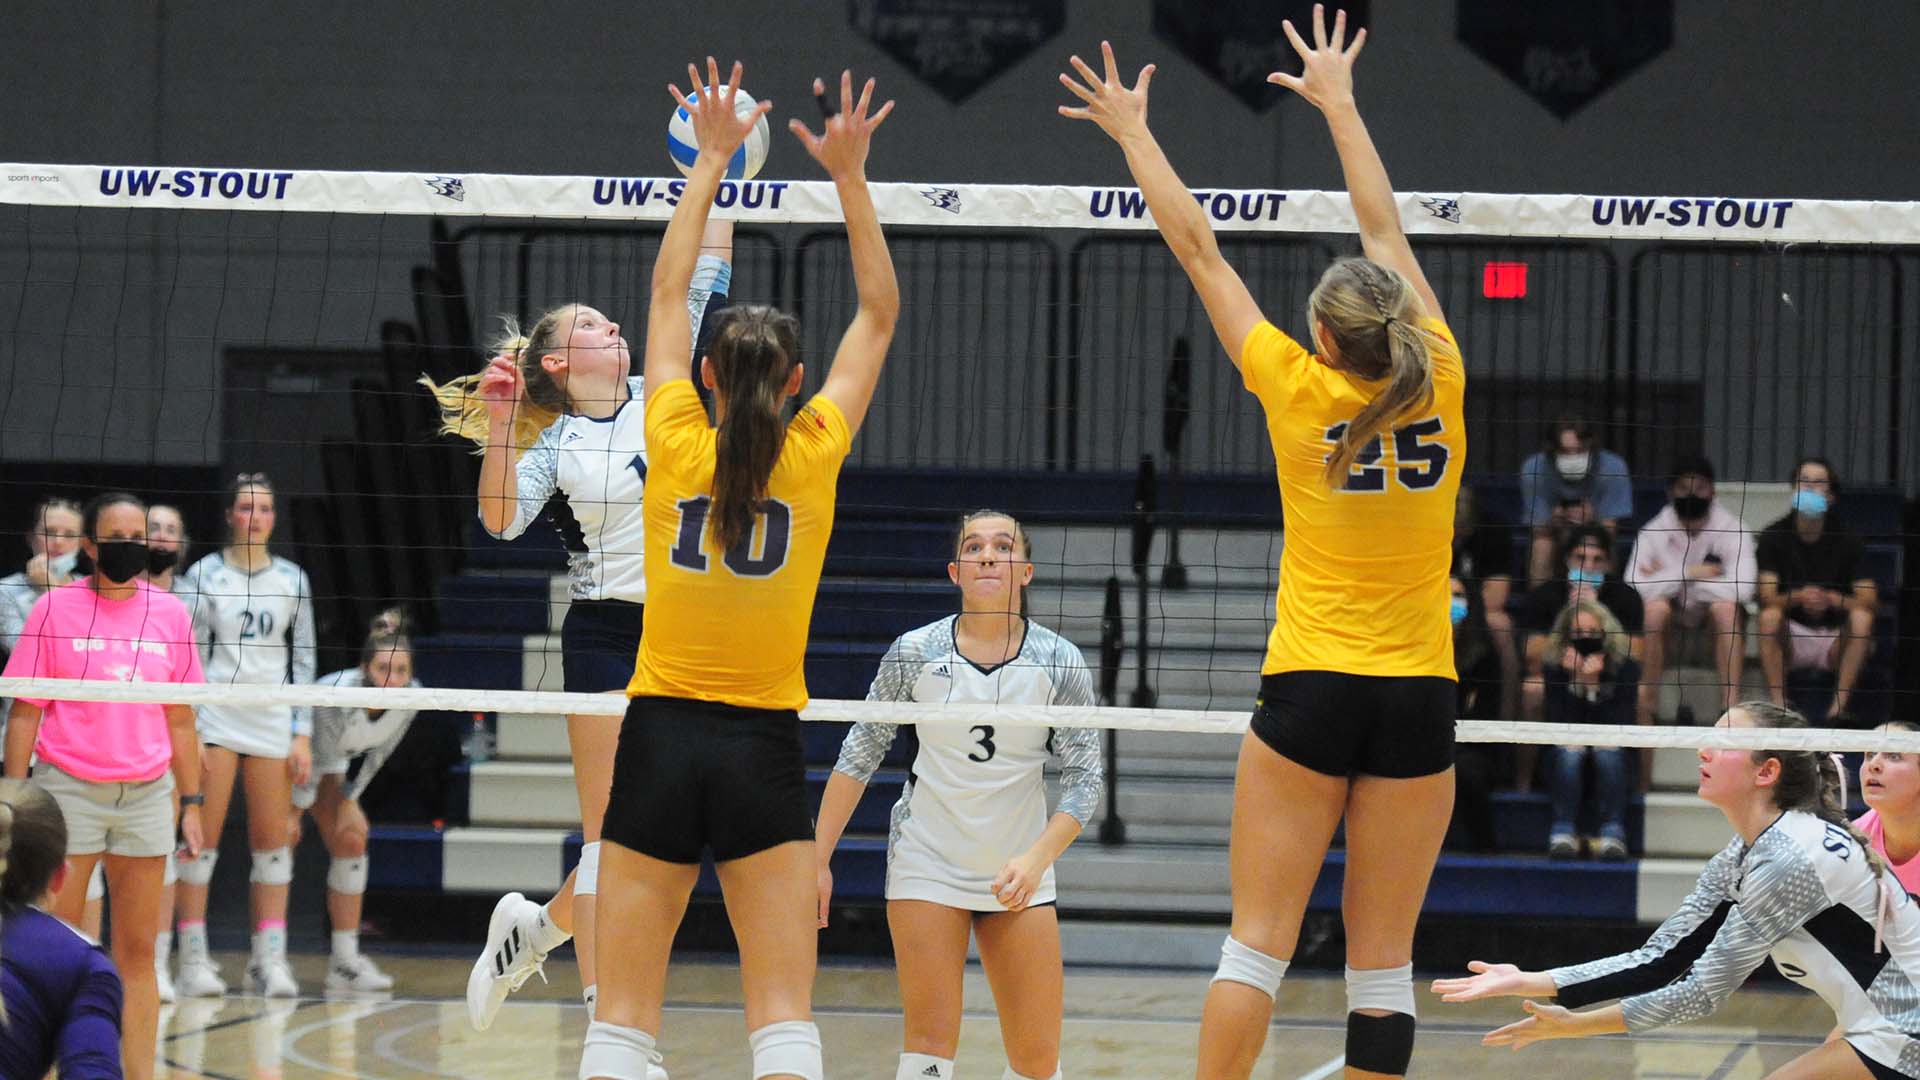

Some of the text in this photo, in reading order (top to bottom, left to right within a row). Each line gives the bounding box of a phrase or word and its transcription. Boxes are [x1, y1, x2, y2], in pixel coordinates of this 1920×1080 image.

[99, 168, 293, 200] UW-STOUT
[593, 178, 788, 210] UW-SOUT
[1591, 198, 1793, 229] UW-STOUT
[1323, 414, 1449, 494] 25
[668, 493, 793, 580] 10
[238, 610, 274, 638] 20
[968, 724, 996, 763] 3
